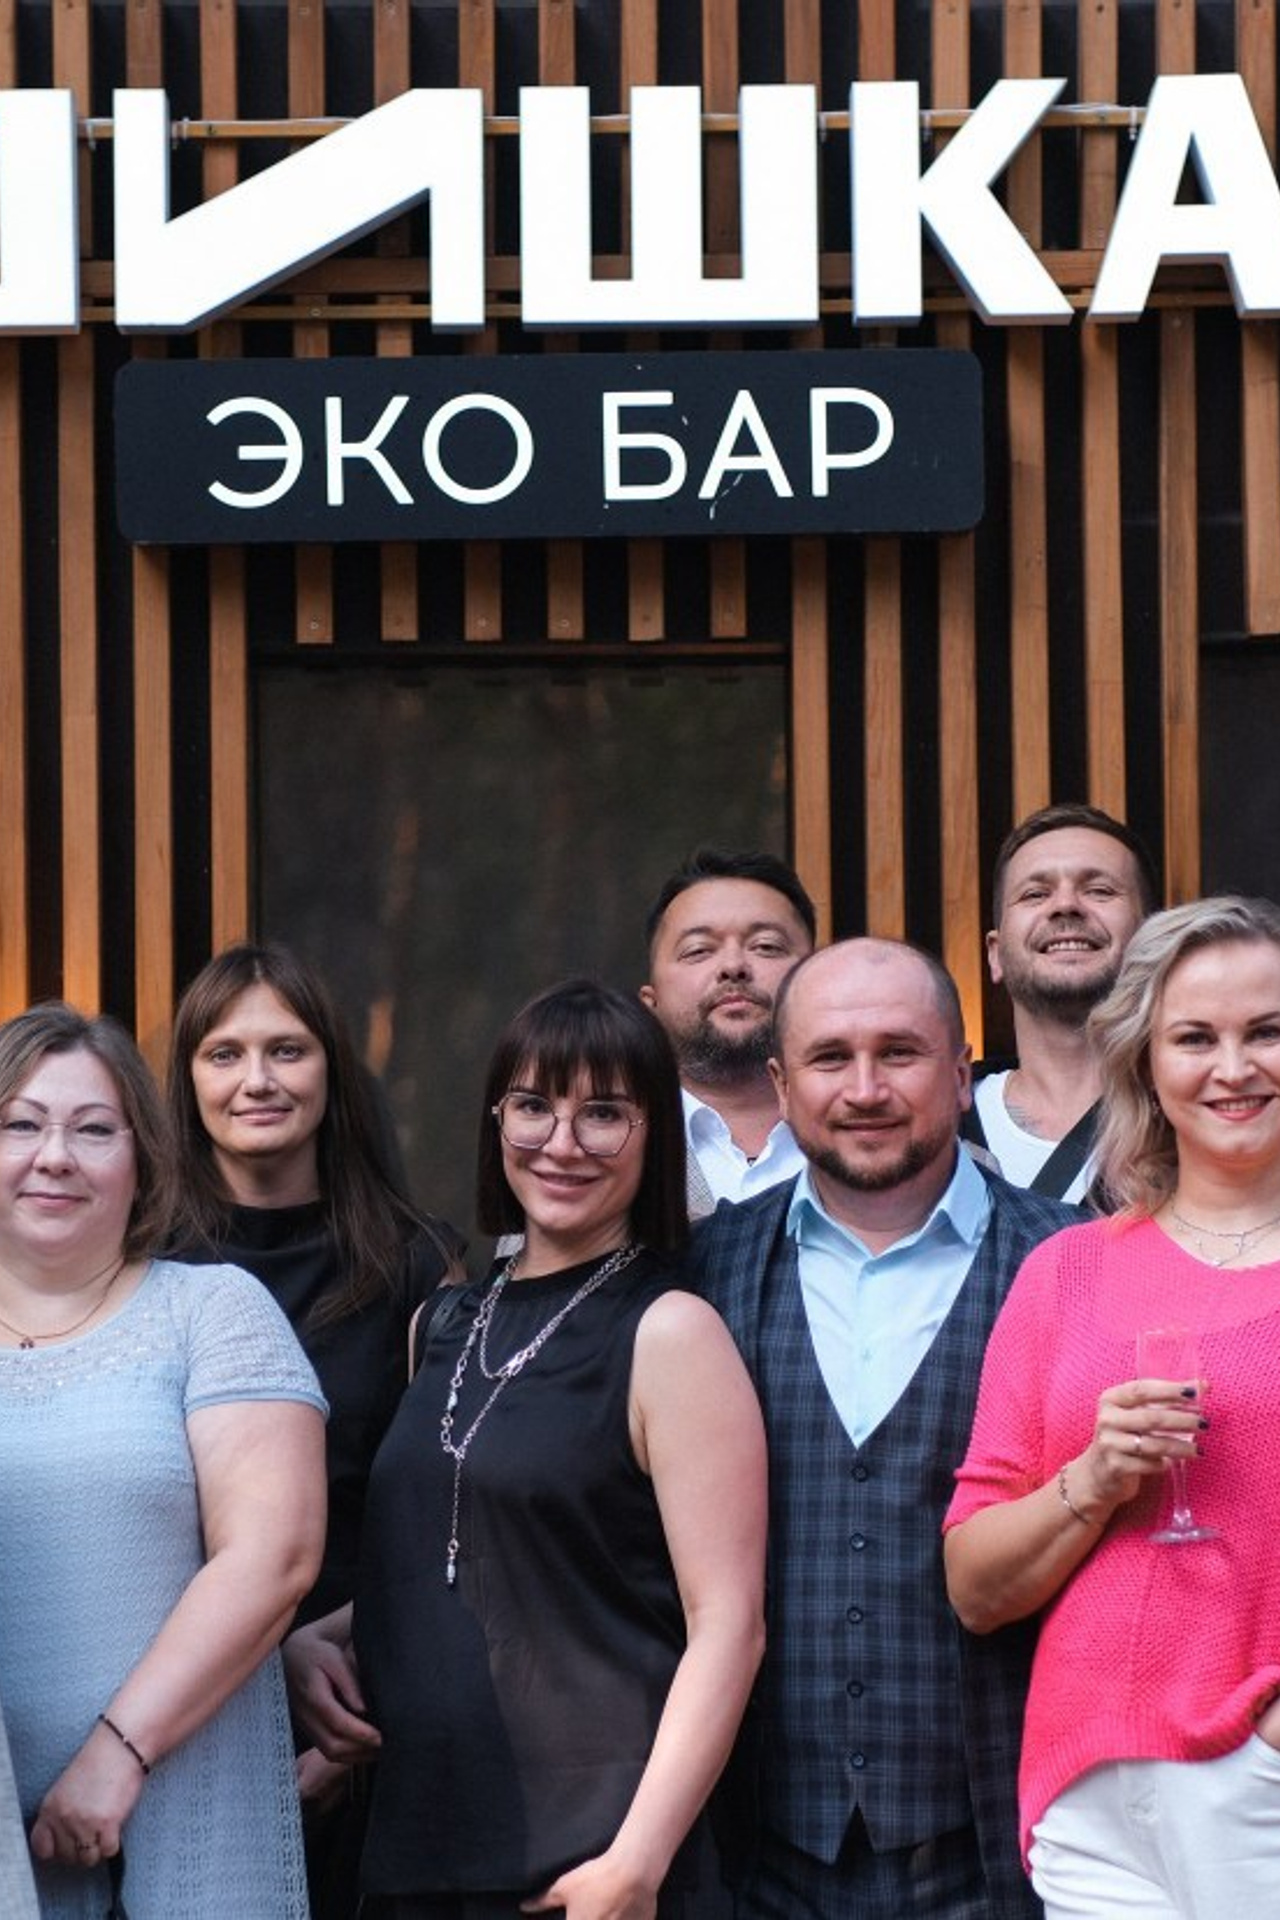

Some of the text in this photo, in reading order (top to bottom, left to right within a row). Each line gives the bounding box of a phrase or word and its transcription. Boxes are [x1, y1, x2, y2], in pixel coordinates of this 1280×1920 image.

[0, 73, 1280, 332] ИШКА
[205, 387, 895, 508] ЭКО БАР
